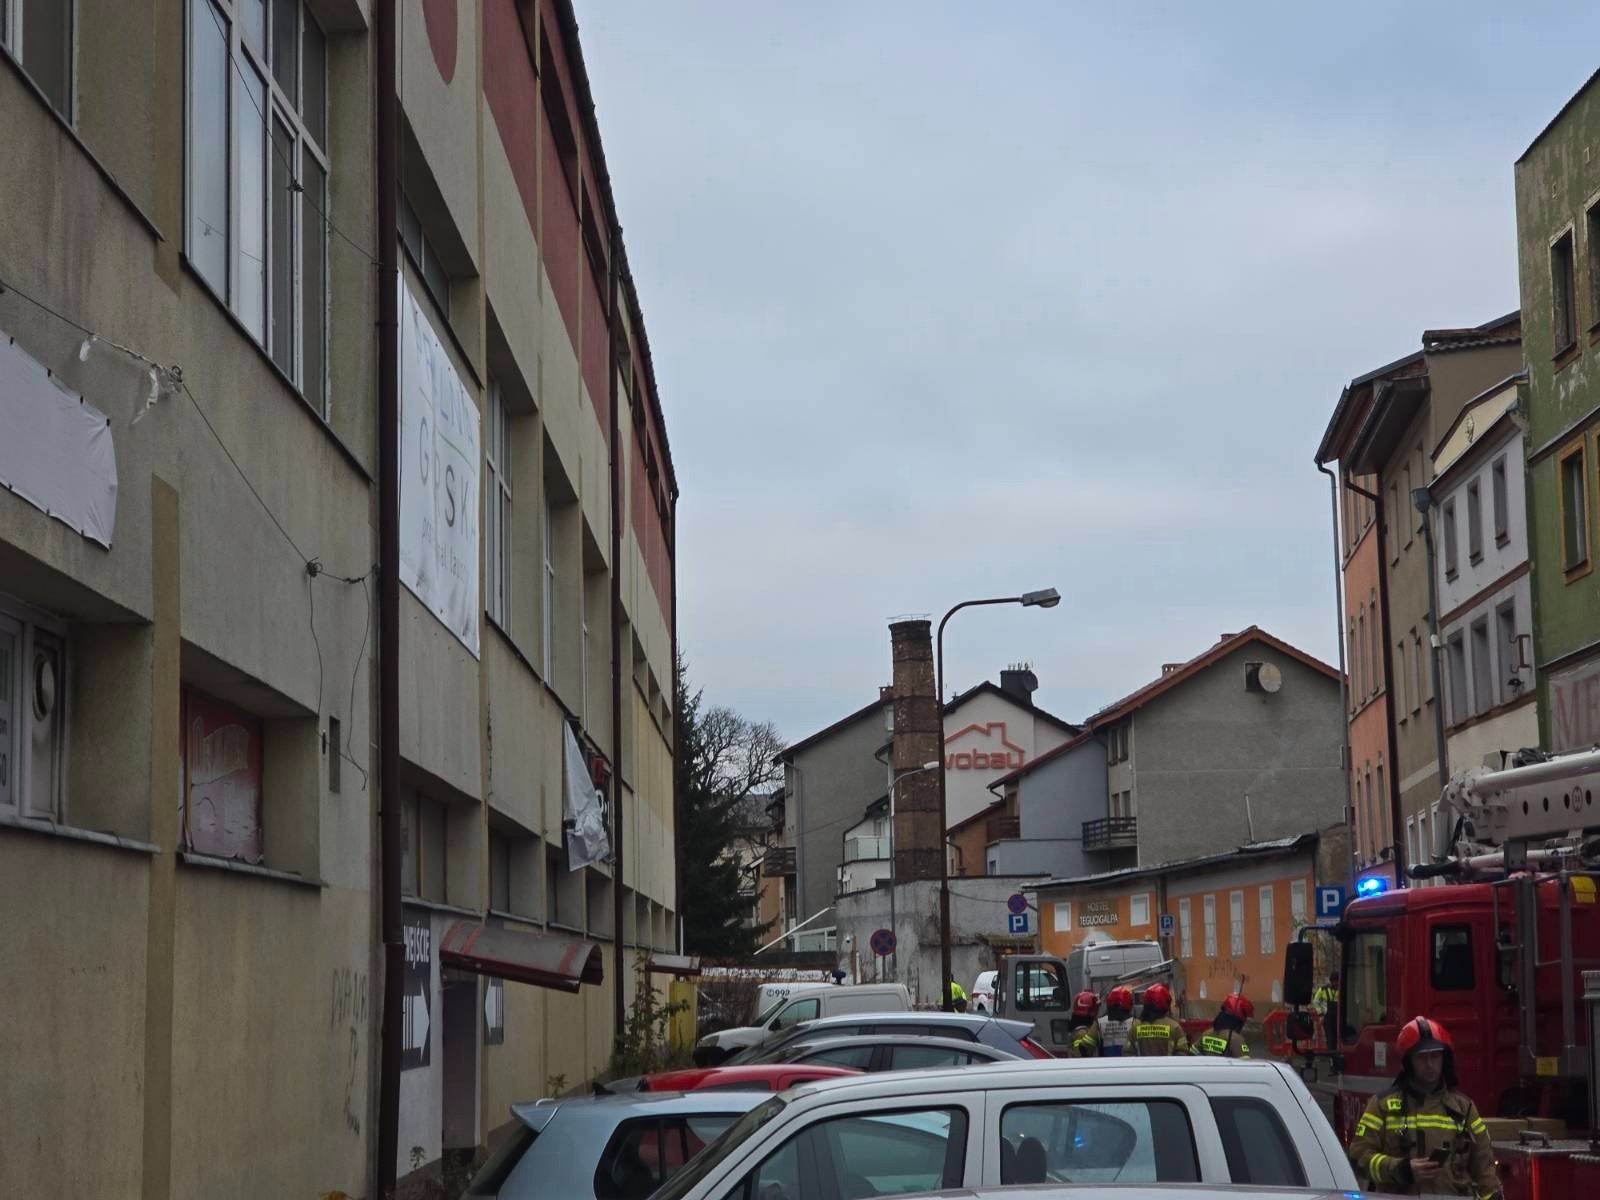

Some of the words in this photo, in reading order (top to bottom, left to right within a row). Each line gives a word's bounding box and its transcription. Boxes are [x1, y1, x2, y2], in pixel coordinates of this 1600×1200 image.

[1322, 889, 1340, 914] P
[1013, 915, 1024, 931] P
[1163, 917, 1171, 928] P
